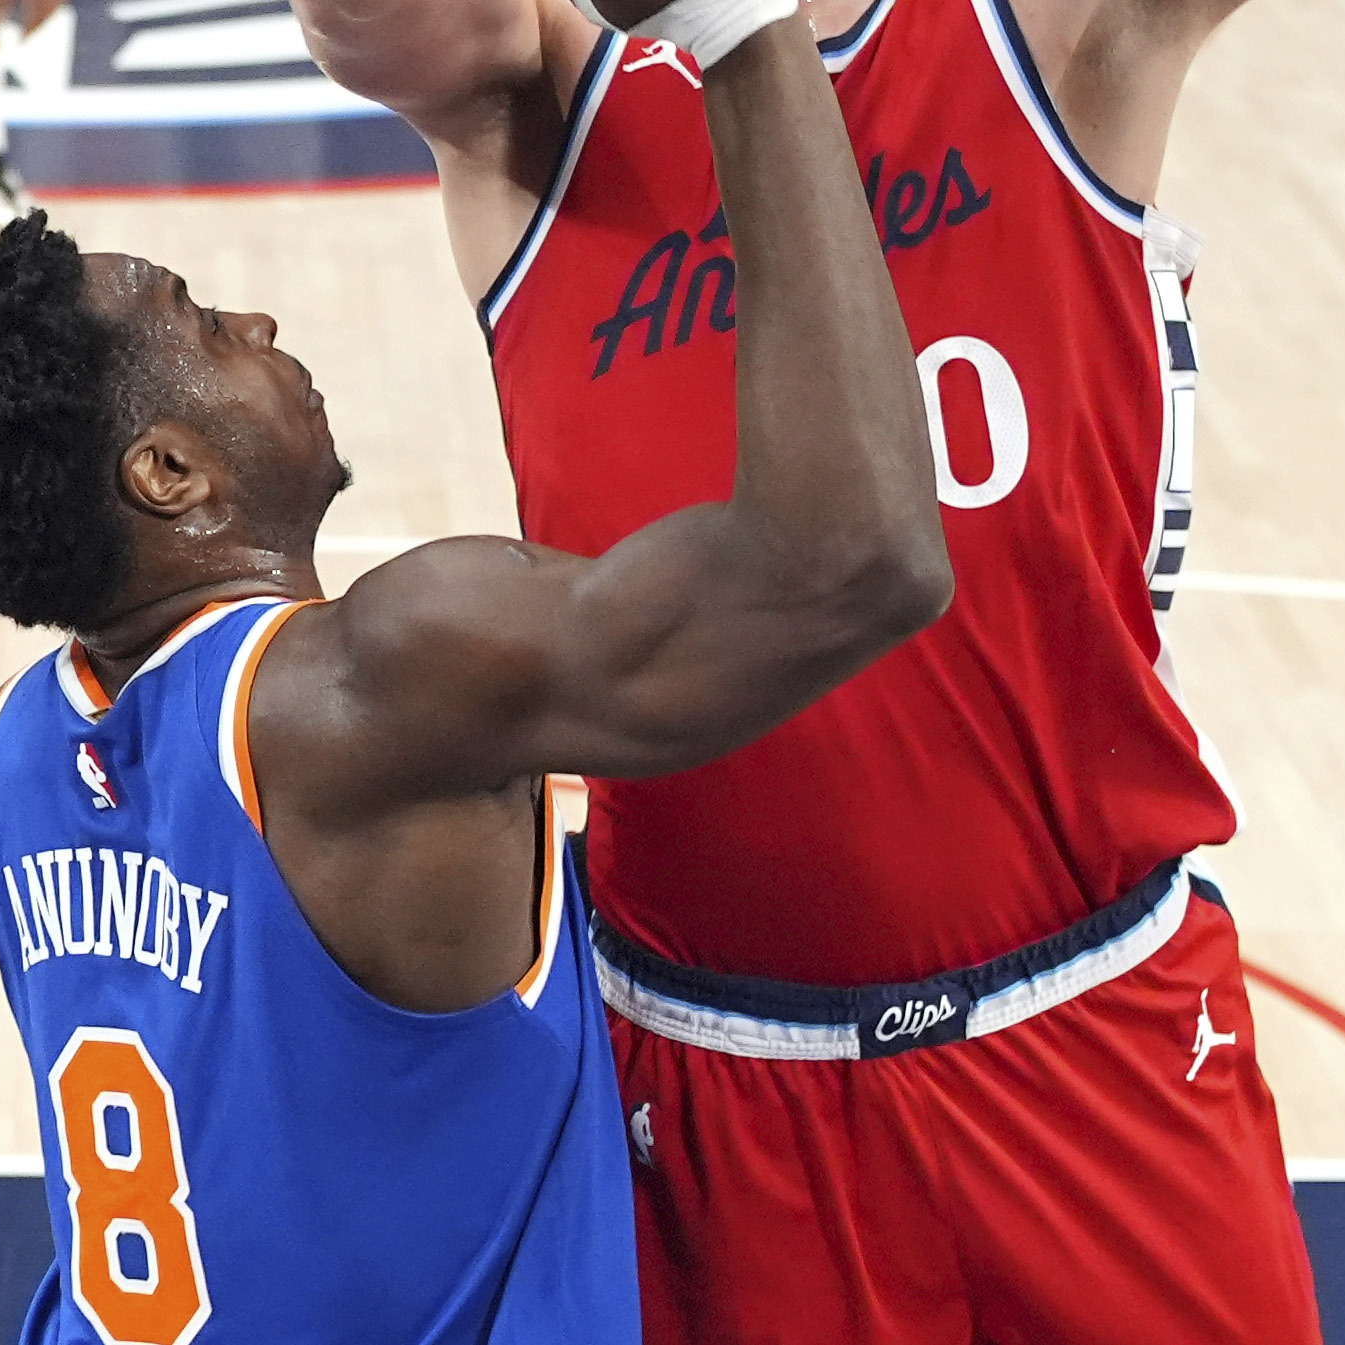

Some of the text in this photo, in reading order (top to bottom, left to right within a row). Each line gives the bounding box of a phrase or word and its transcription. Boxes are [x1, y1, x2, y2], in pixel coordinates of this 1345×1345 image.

[3, 846, 229, 995] ANUNOBY
[874, 994, 957, 1042] Clips
[48, 1026, 213, 1345] 8
